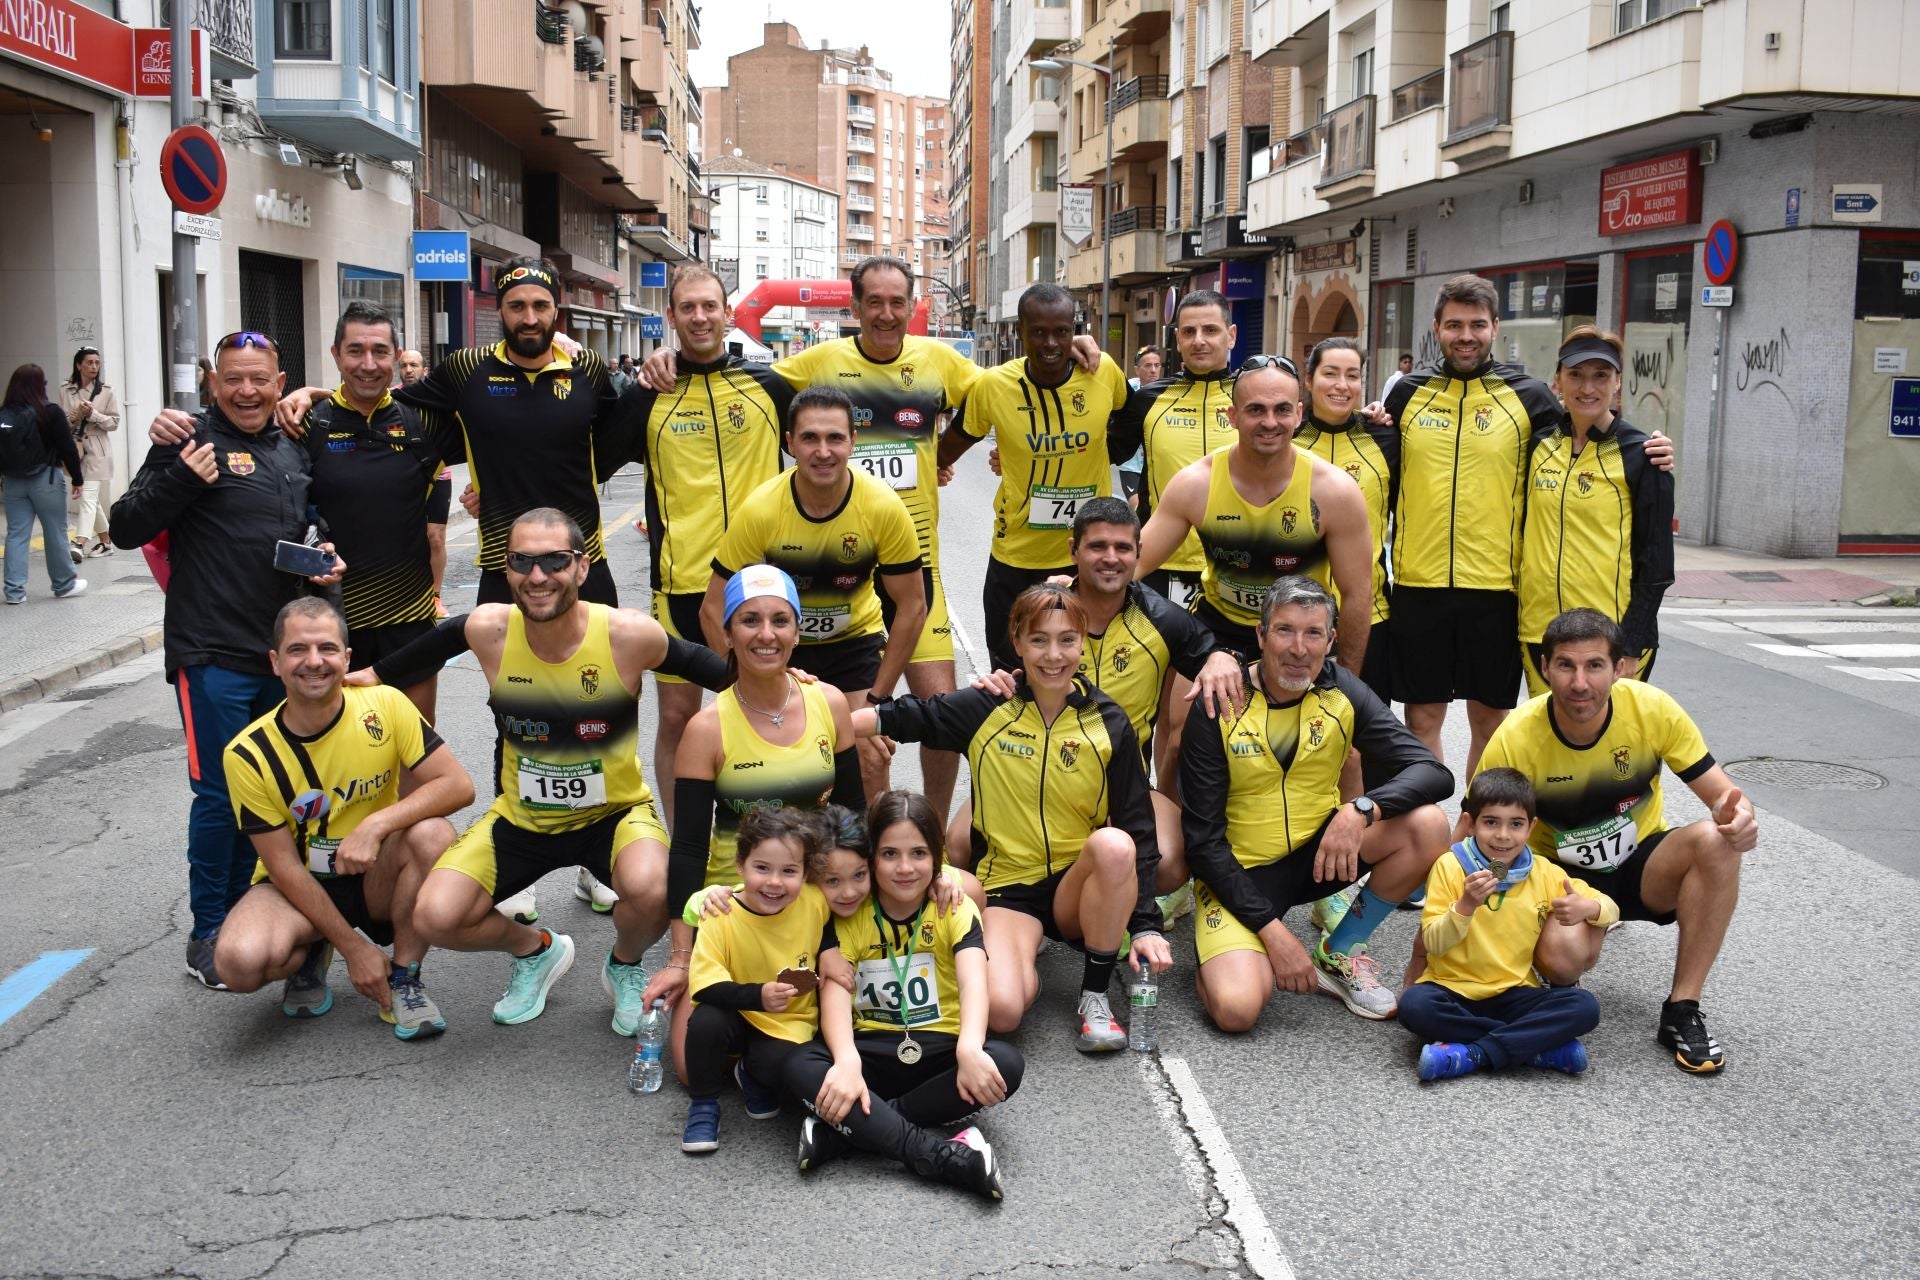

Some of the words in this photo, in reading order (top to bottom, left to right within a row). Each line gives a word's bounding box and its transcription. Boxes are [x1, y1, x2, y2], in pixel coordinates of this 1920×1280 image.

[0, 0, 77, 61] NERALI
[1605, 164, 1657, 186] INSTRUMENTOS
[1636, 180, 1662, 197] ALQUILER
[1667, 178, 1686, 191] VENTA
[1644, 200, 1652, 210] DE
[1652, 195, 1676, 210] EQUIPOS
[415, 250, 466, 263] adriels
[642, 324, 663, 333] TAXI
[899, 412, 920, 424] BENIS
[1164, 415, 1197, 427] Virto
[1418, 415, 1450, 429] Virto
[1893, 415, 1914, 426] 941
[670, 420, 706, 433] Virto
[1026, 430, 1090, 452] Virto
[861, 456, 902, 479] 310
[1051, 500, 1077, 519] 74
[1275, 557, 1297, 566] BENIS
[836, 576, 857, 585] BENIS
[1232, 590, 1265, 607] 18
[800, 617, 834, 632] 28
[500, 713, 549, 735] Virto
[579, 723, 607, 734] BENIS
[997, 738, 1035, 756] Virto
[535, 762, 561, 771] CARRERA
[562, 762, 591, 771] POPULAR
[331, 768, 391, 802] Virto
[535, 776, 586, 799] 159
[1572, 827, 1600, 837] CARRERA
[1576, 831, 1621, 867] 317
[862, 976, 930, 1010] 130
